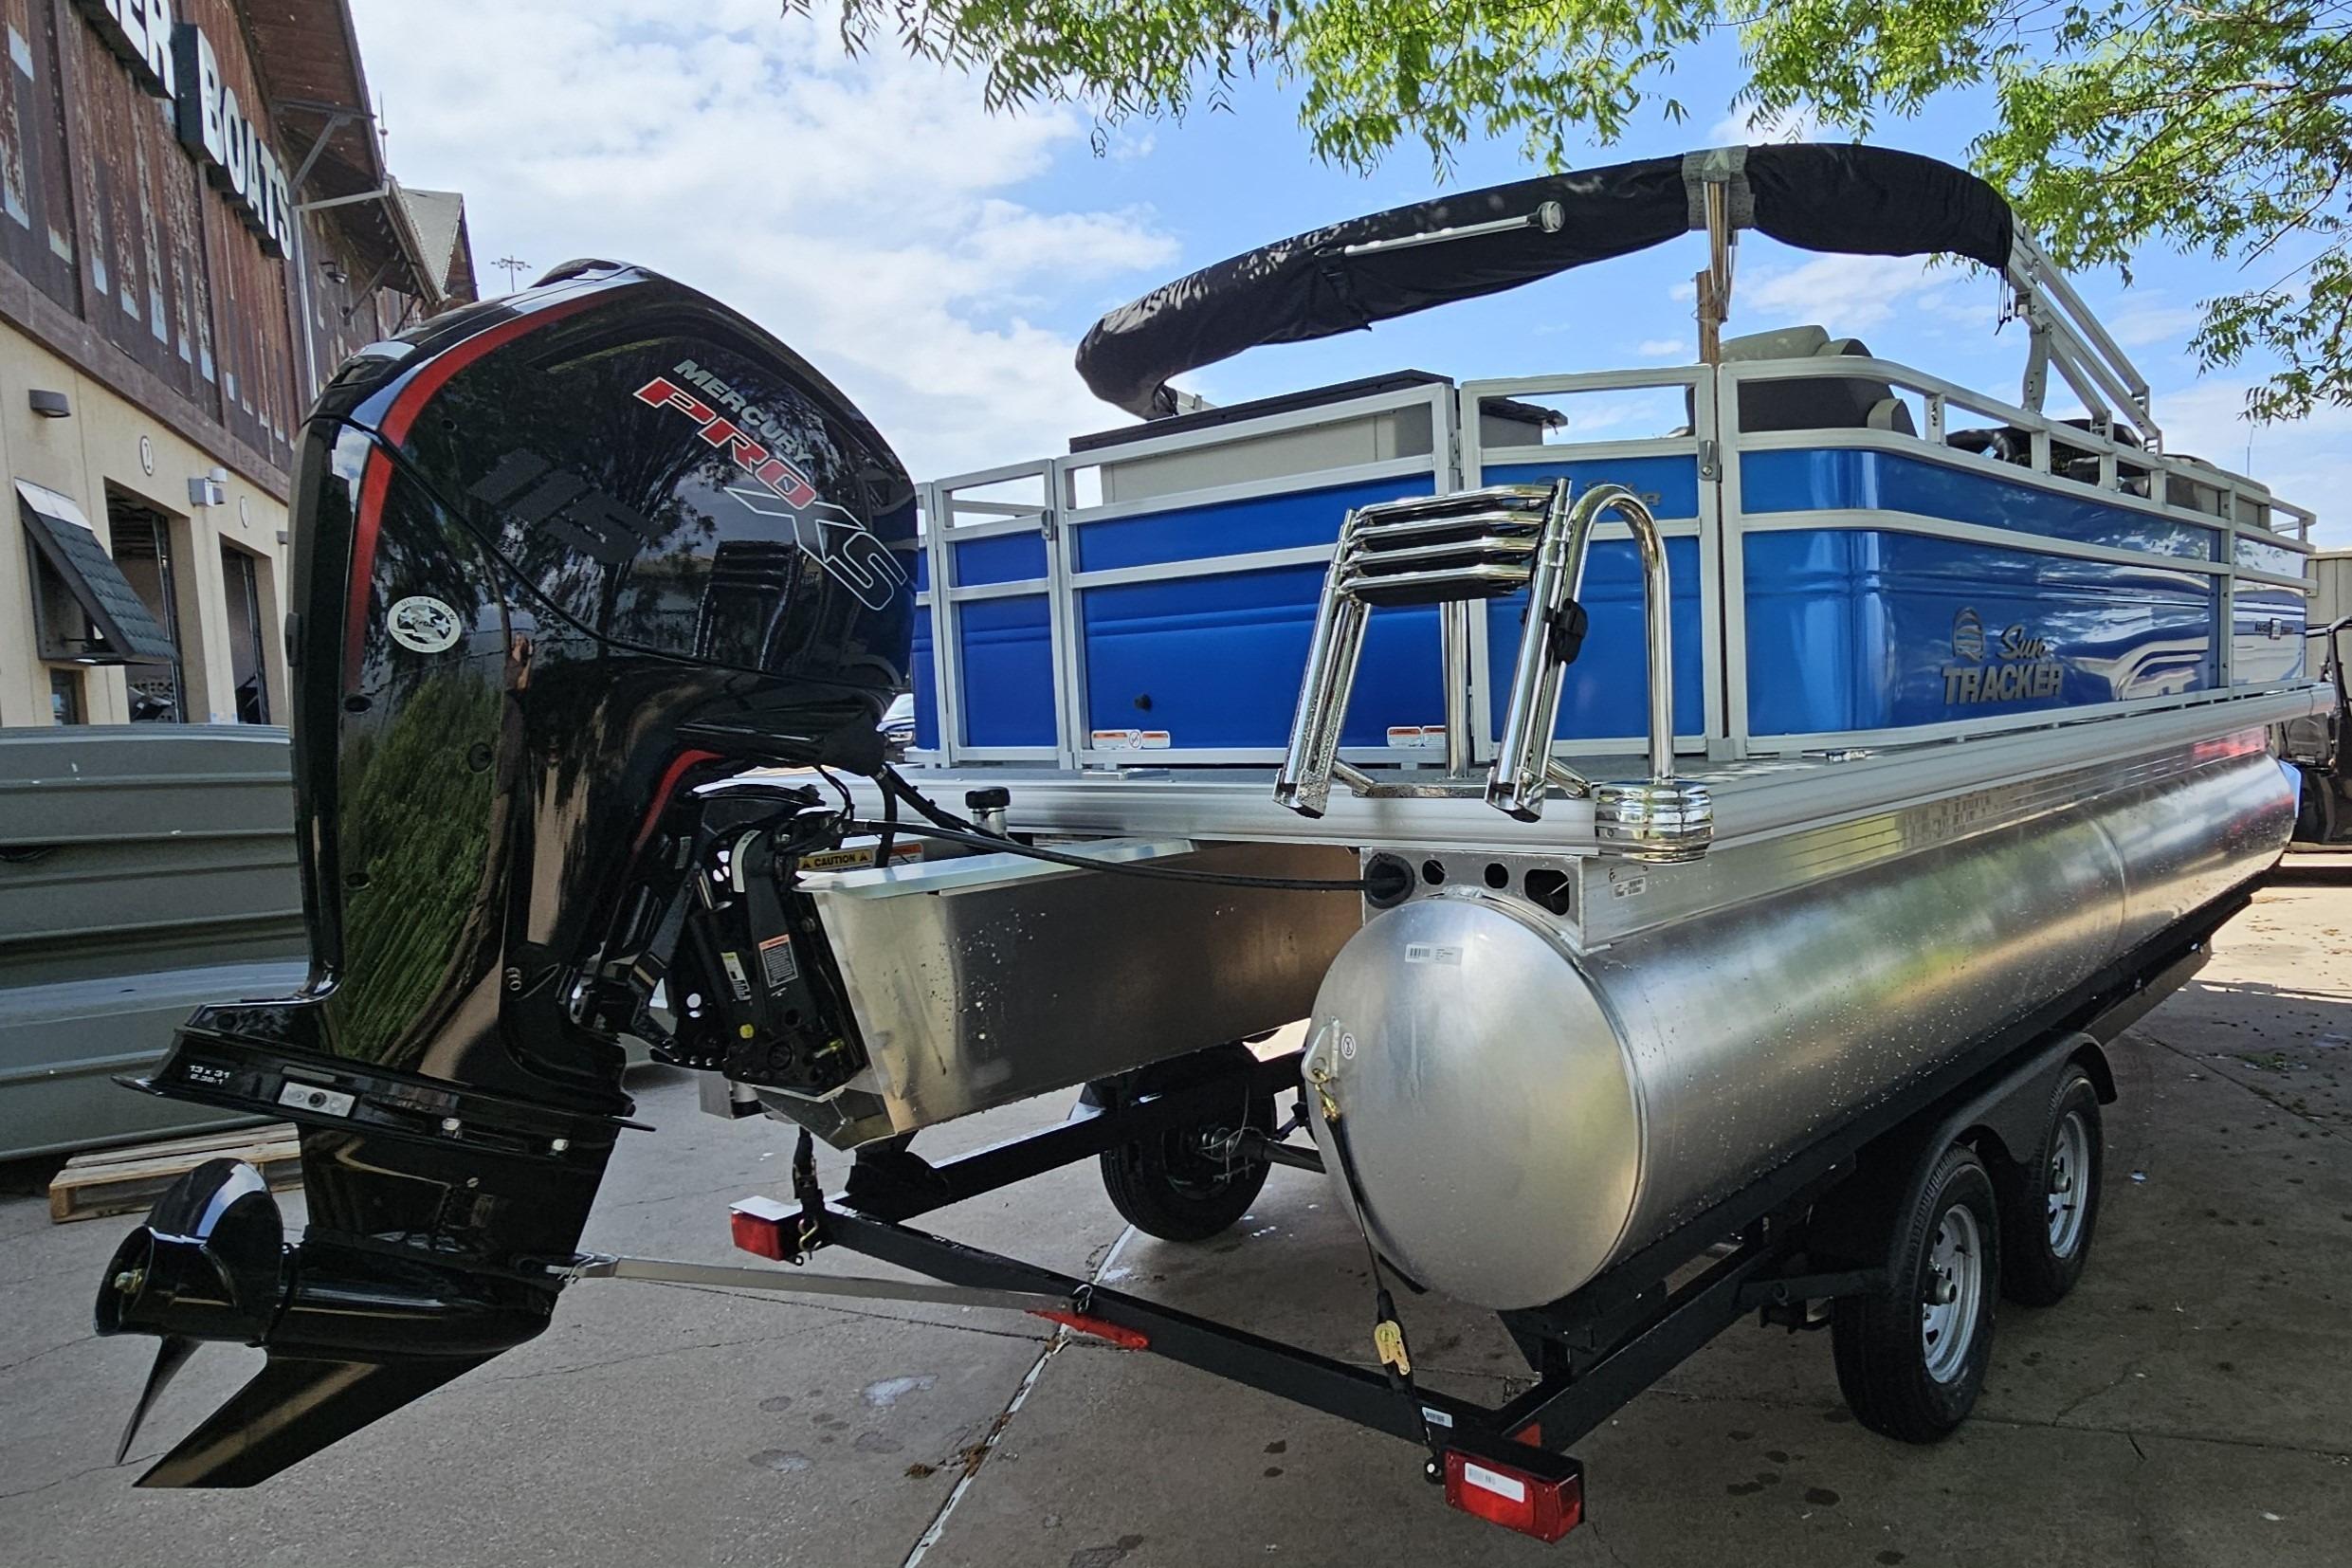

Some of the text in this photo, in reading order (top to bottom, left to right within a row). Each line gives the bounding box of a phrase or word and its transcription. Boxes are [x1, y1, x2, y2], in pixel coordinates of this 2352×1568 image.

[197, 27, 293, 260] BOATS
[672, 358, 815, 464] MERCURY
[632, 375, 908, 611] PRO XS
[1996, 624, 2046, 661] Sun
[1942, 663, 2064, 705] TRACKER
[813, 854, 856, 867] CAUTION
[190, 1065, 204, 1074] 13
[213, 1069, 231, 1079] 31
